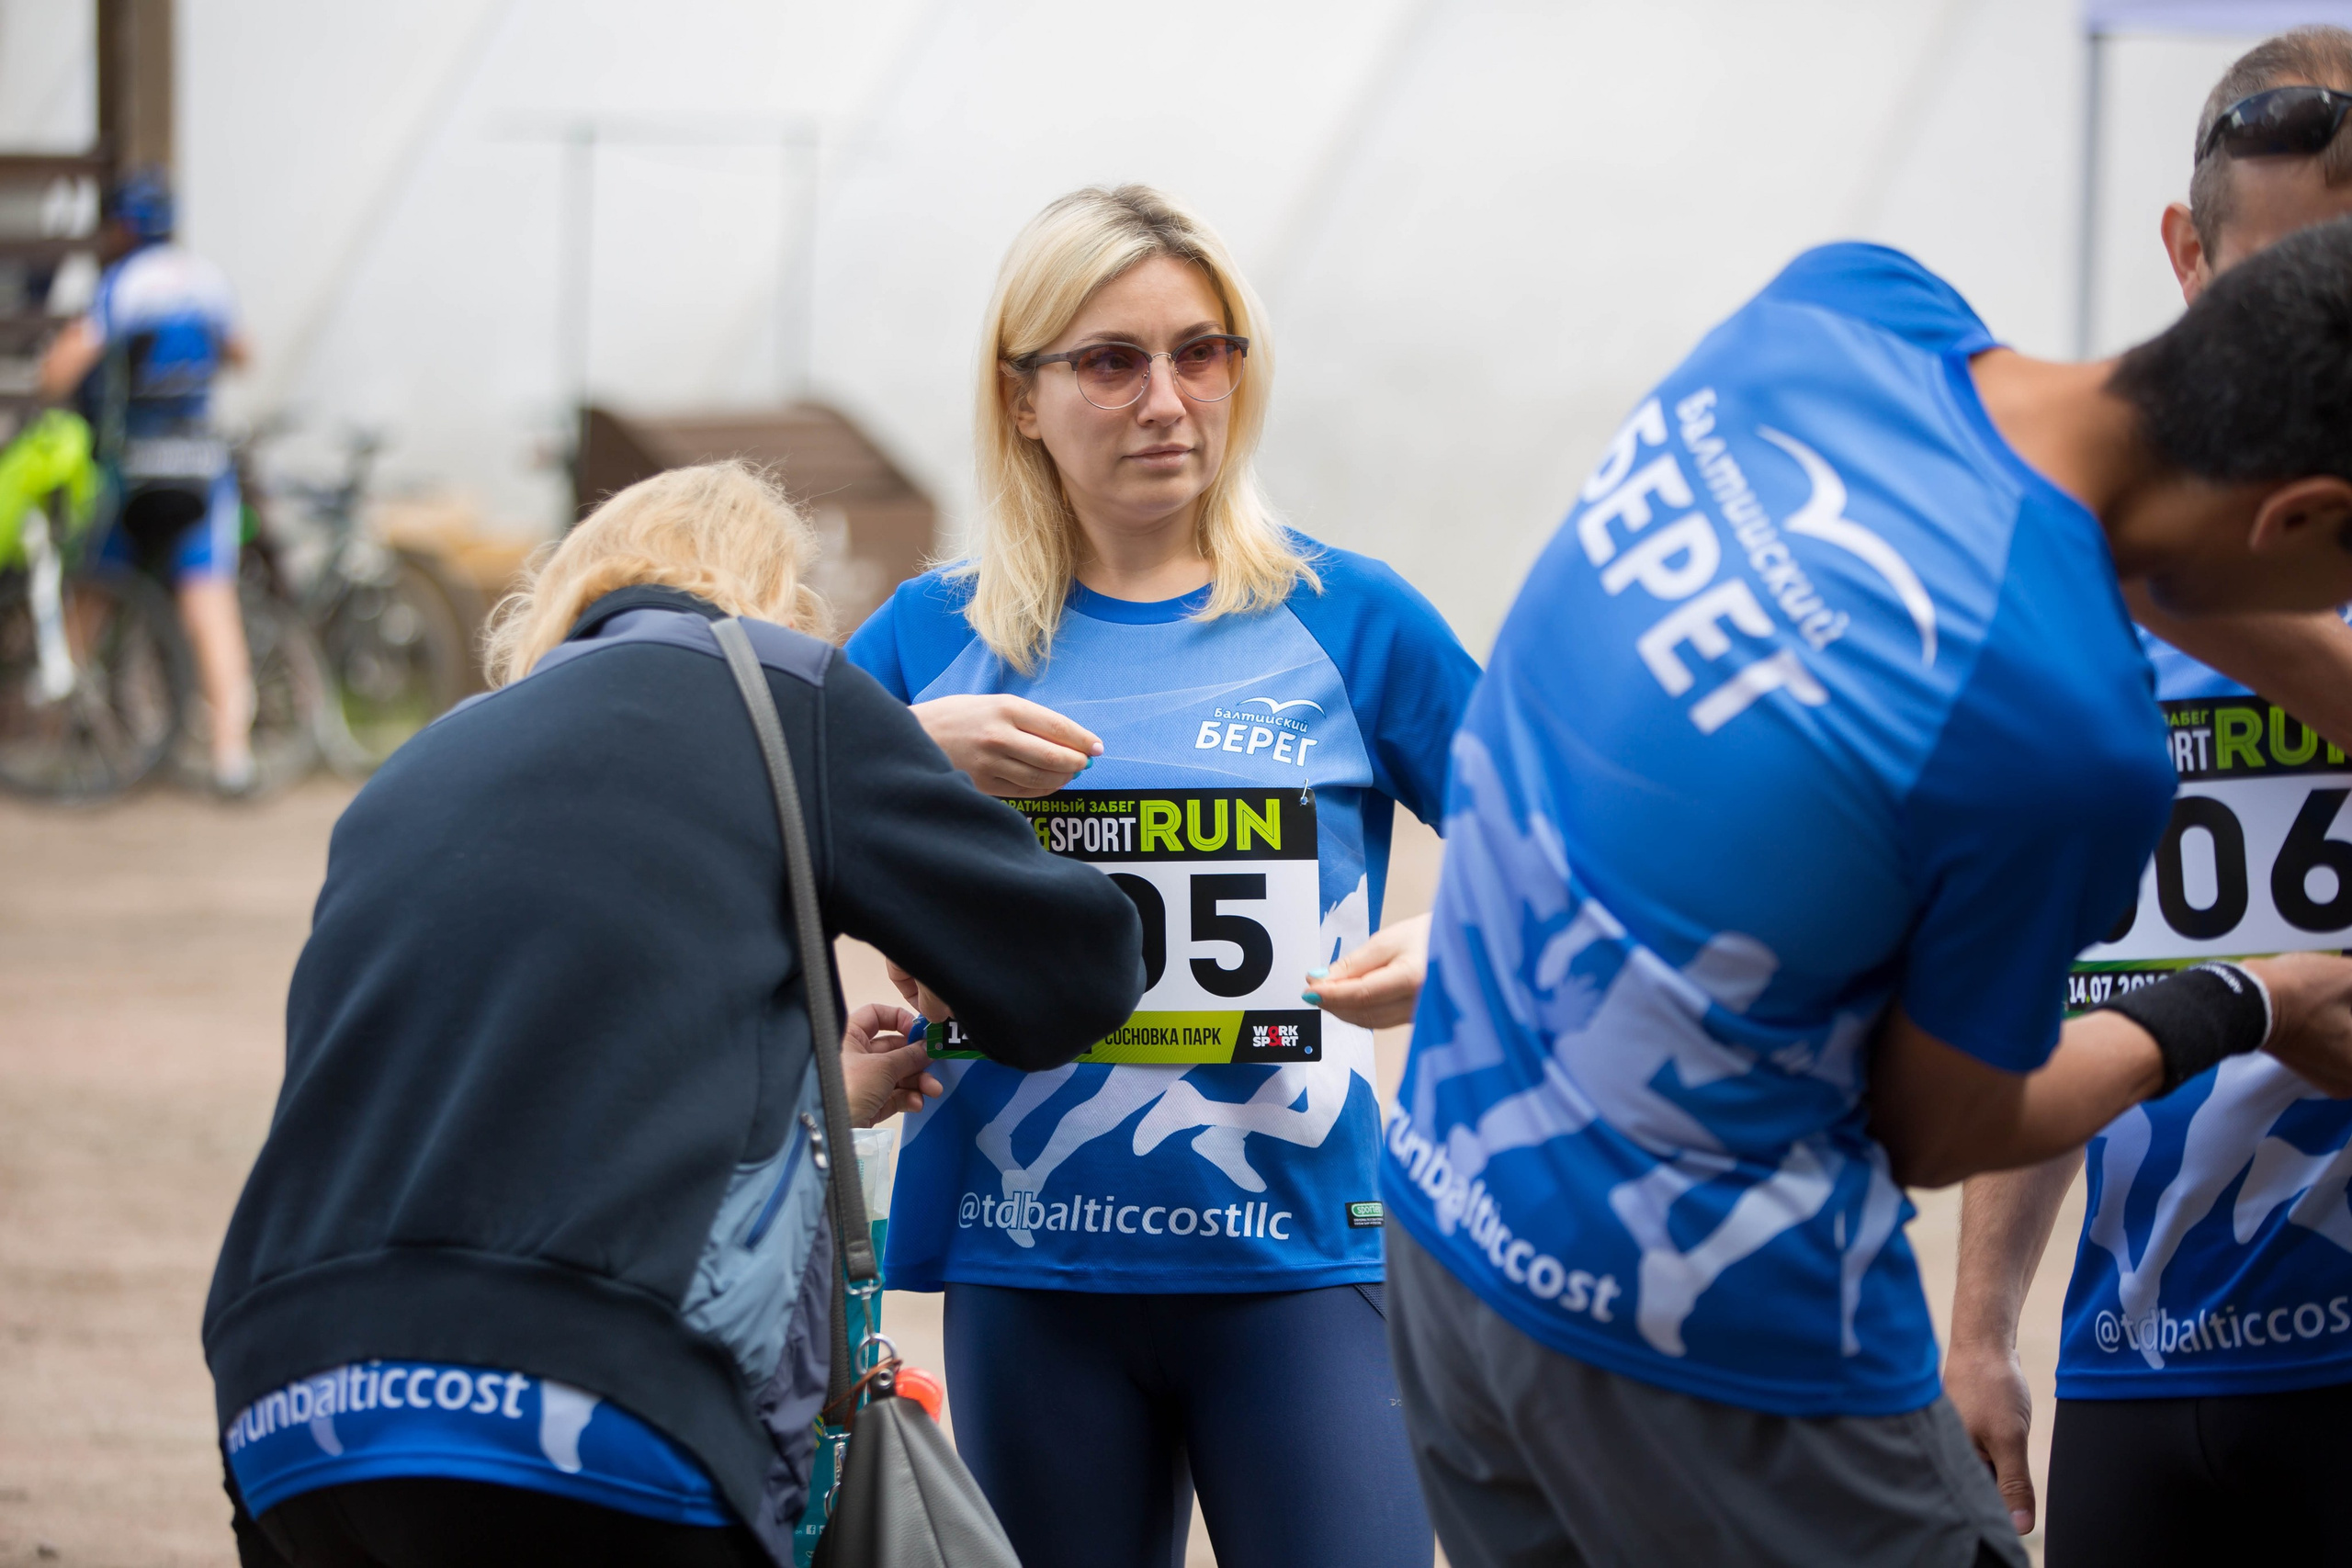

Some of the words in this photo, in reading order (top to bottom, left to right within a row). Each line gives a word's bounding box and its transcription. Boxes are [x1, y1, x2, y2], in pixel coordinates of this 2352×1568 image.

[1577, 395, 1830, 736] БЕРЕГ
[1194, 720, 1318, 767] БЕРЕГ
[1089, 800, 1136, 813] ЗАБЕГ
[1139, 798, 1282, 852] RUN
[2100, 787, 2352, 945] 06
[1104, 1027, 1180, 1045] СОСНОВКА
[1182, 1027, 1222, 1045] ПАРК
